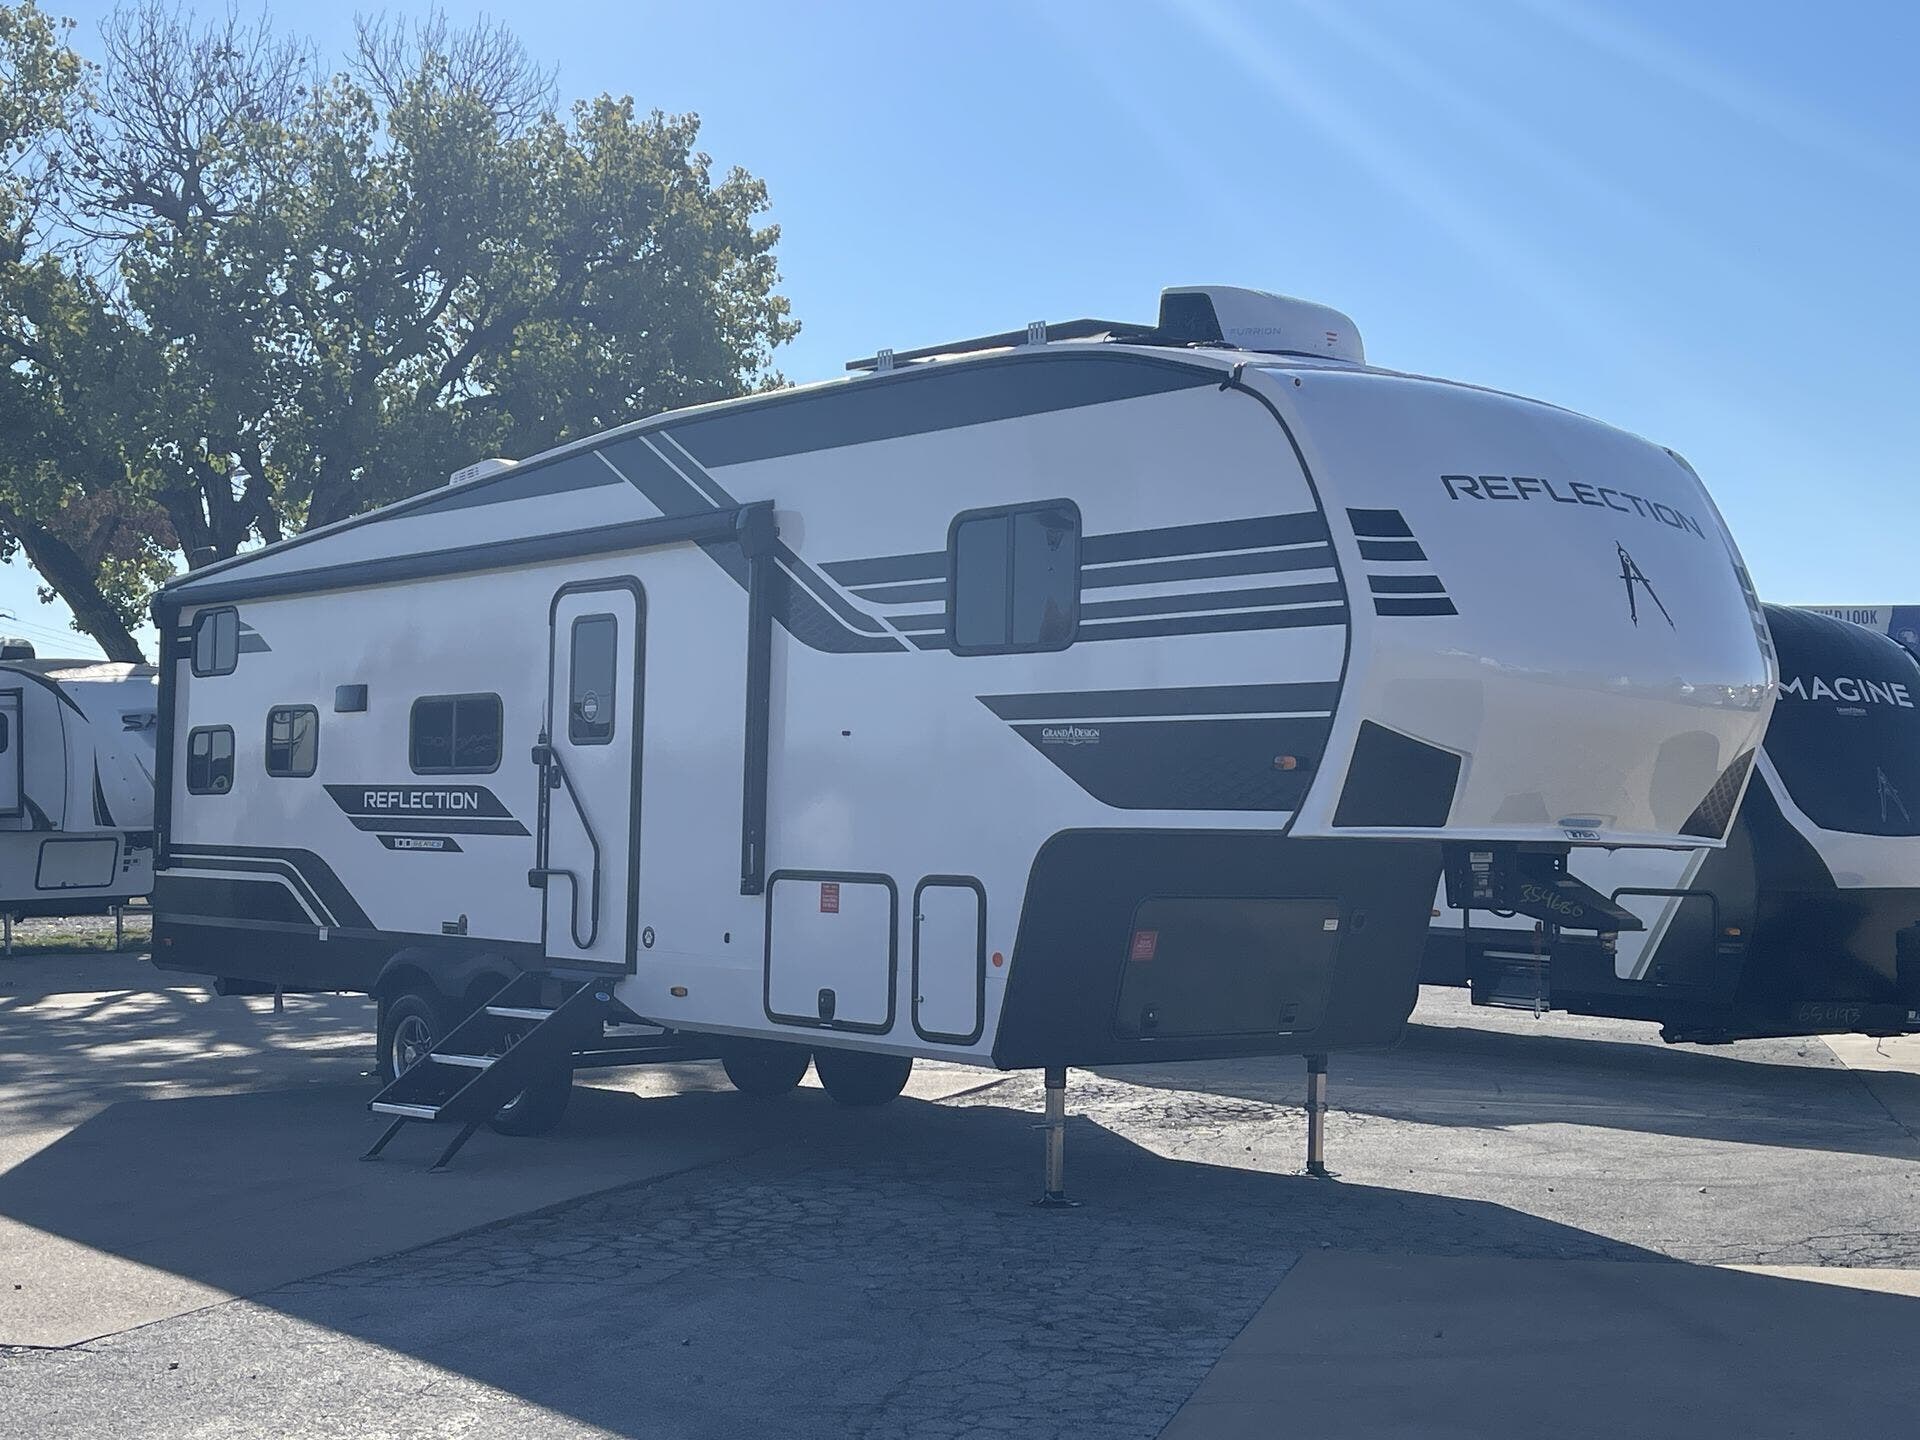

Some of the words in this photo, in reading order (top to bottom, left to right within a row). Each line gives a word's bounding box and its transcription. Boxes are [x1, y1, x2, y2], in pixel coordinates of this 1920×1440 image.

[1440, 474, 1706, 540] REFLECTION
[1776, 676, 1915, 709] MAGINE
[1042, 727, 1068, 738] GRAND
[1074, 727, 1100, 738] DESIGN
[363, 791, 478, 810] REFLECTION
